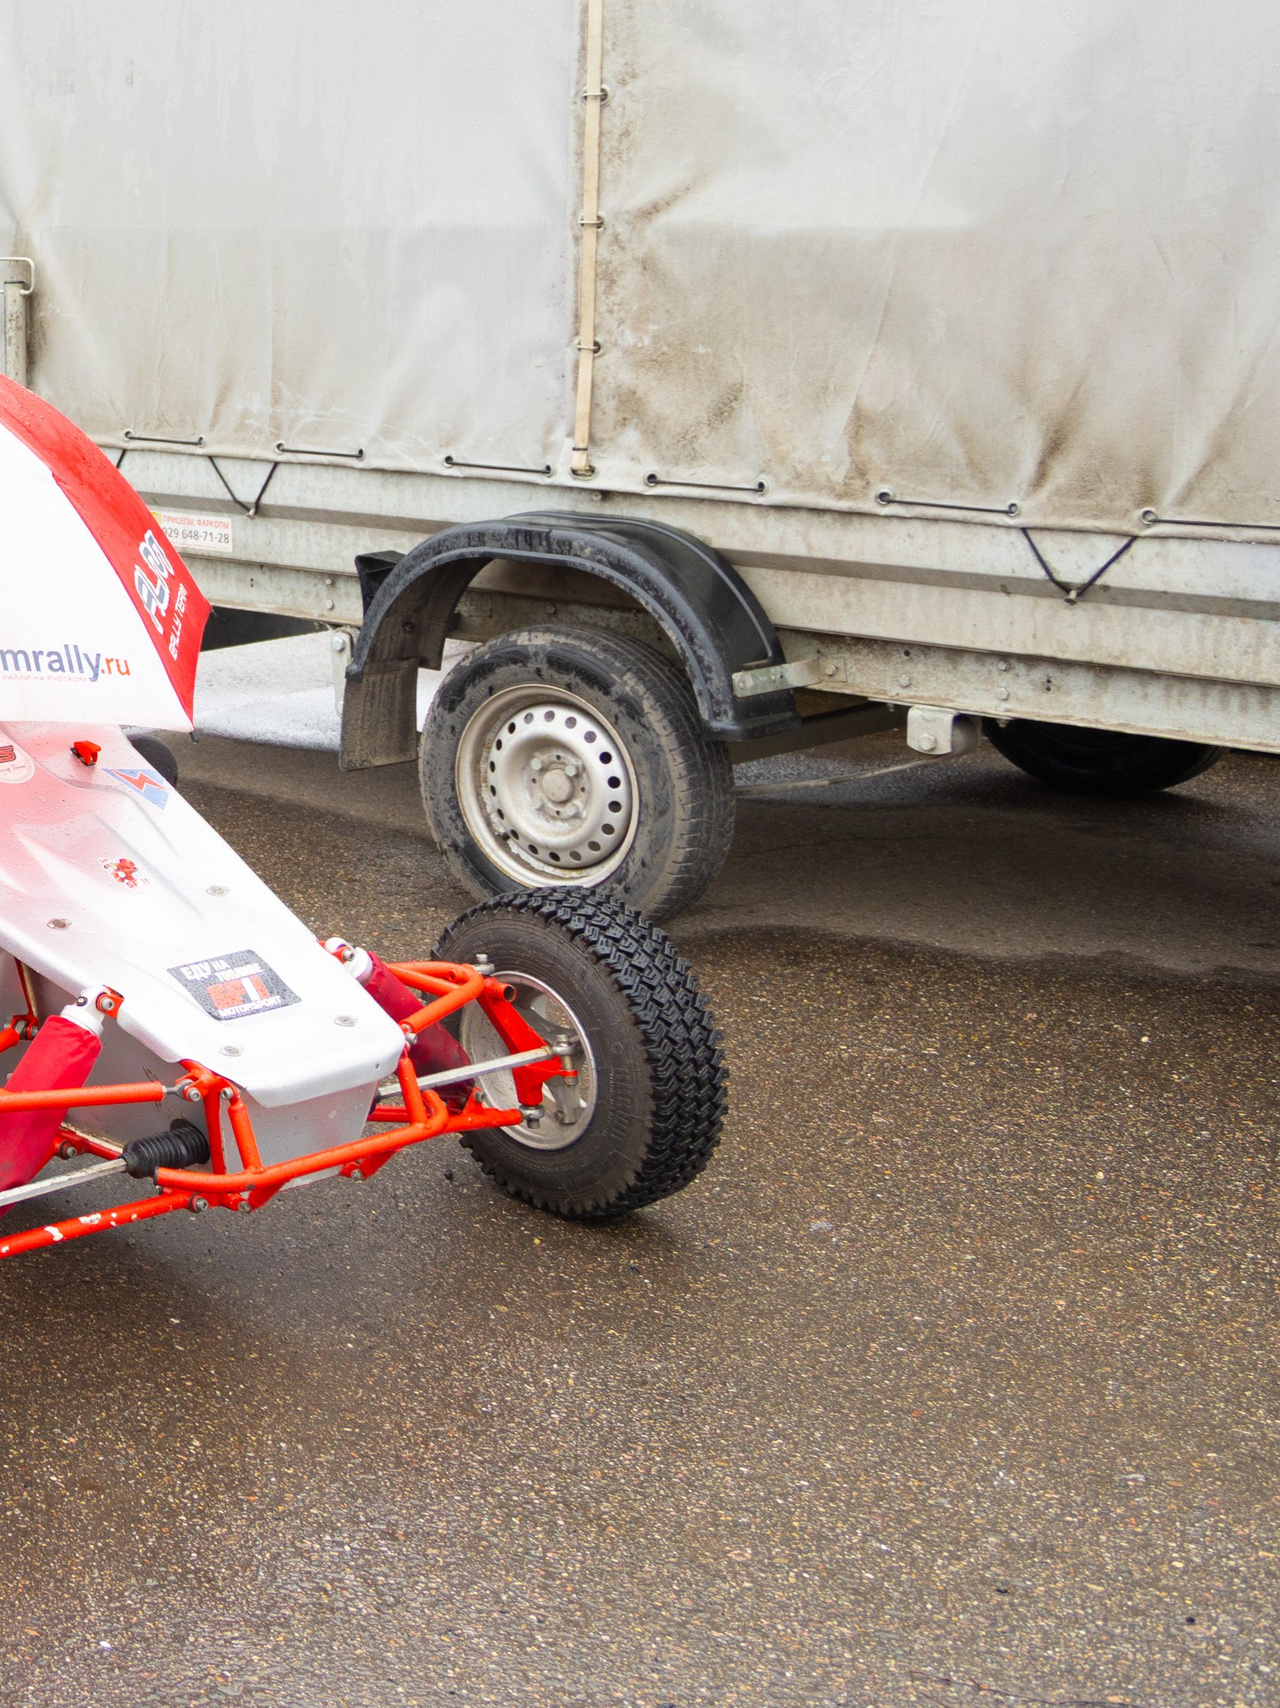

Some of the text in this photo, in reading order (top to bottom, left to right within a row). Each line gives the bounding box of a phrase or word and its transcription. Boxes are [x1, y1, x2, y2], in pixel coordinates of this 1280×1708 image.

[197, 518, 229, 529] ФАРКОПЫ
[181, 529, 230, 544] 648-71-28
[168, 583, 189, 661] RALLY TEAM
[180, 959, 231, 981] ЕДУ НА
[218, 995, 282, 1017] MOTORSPORT
